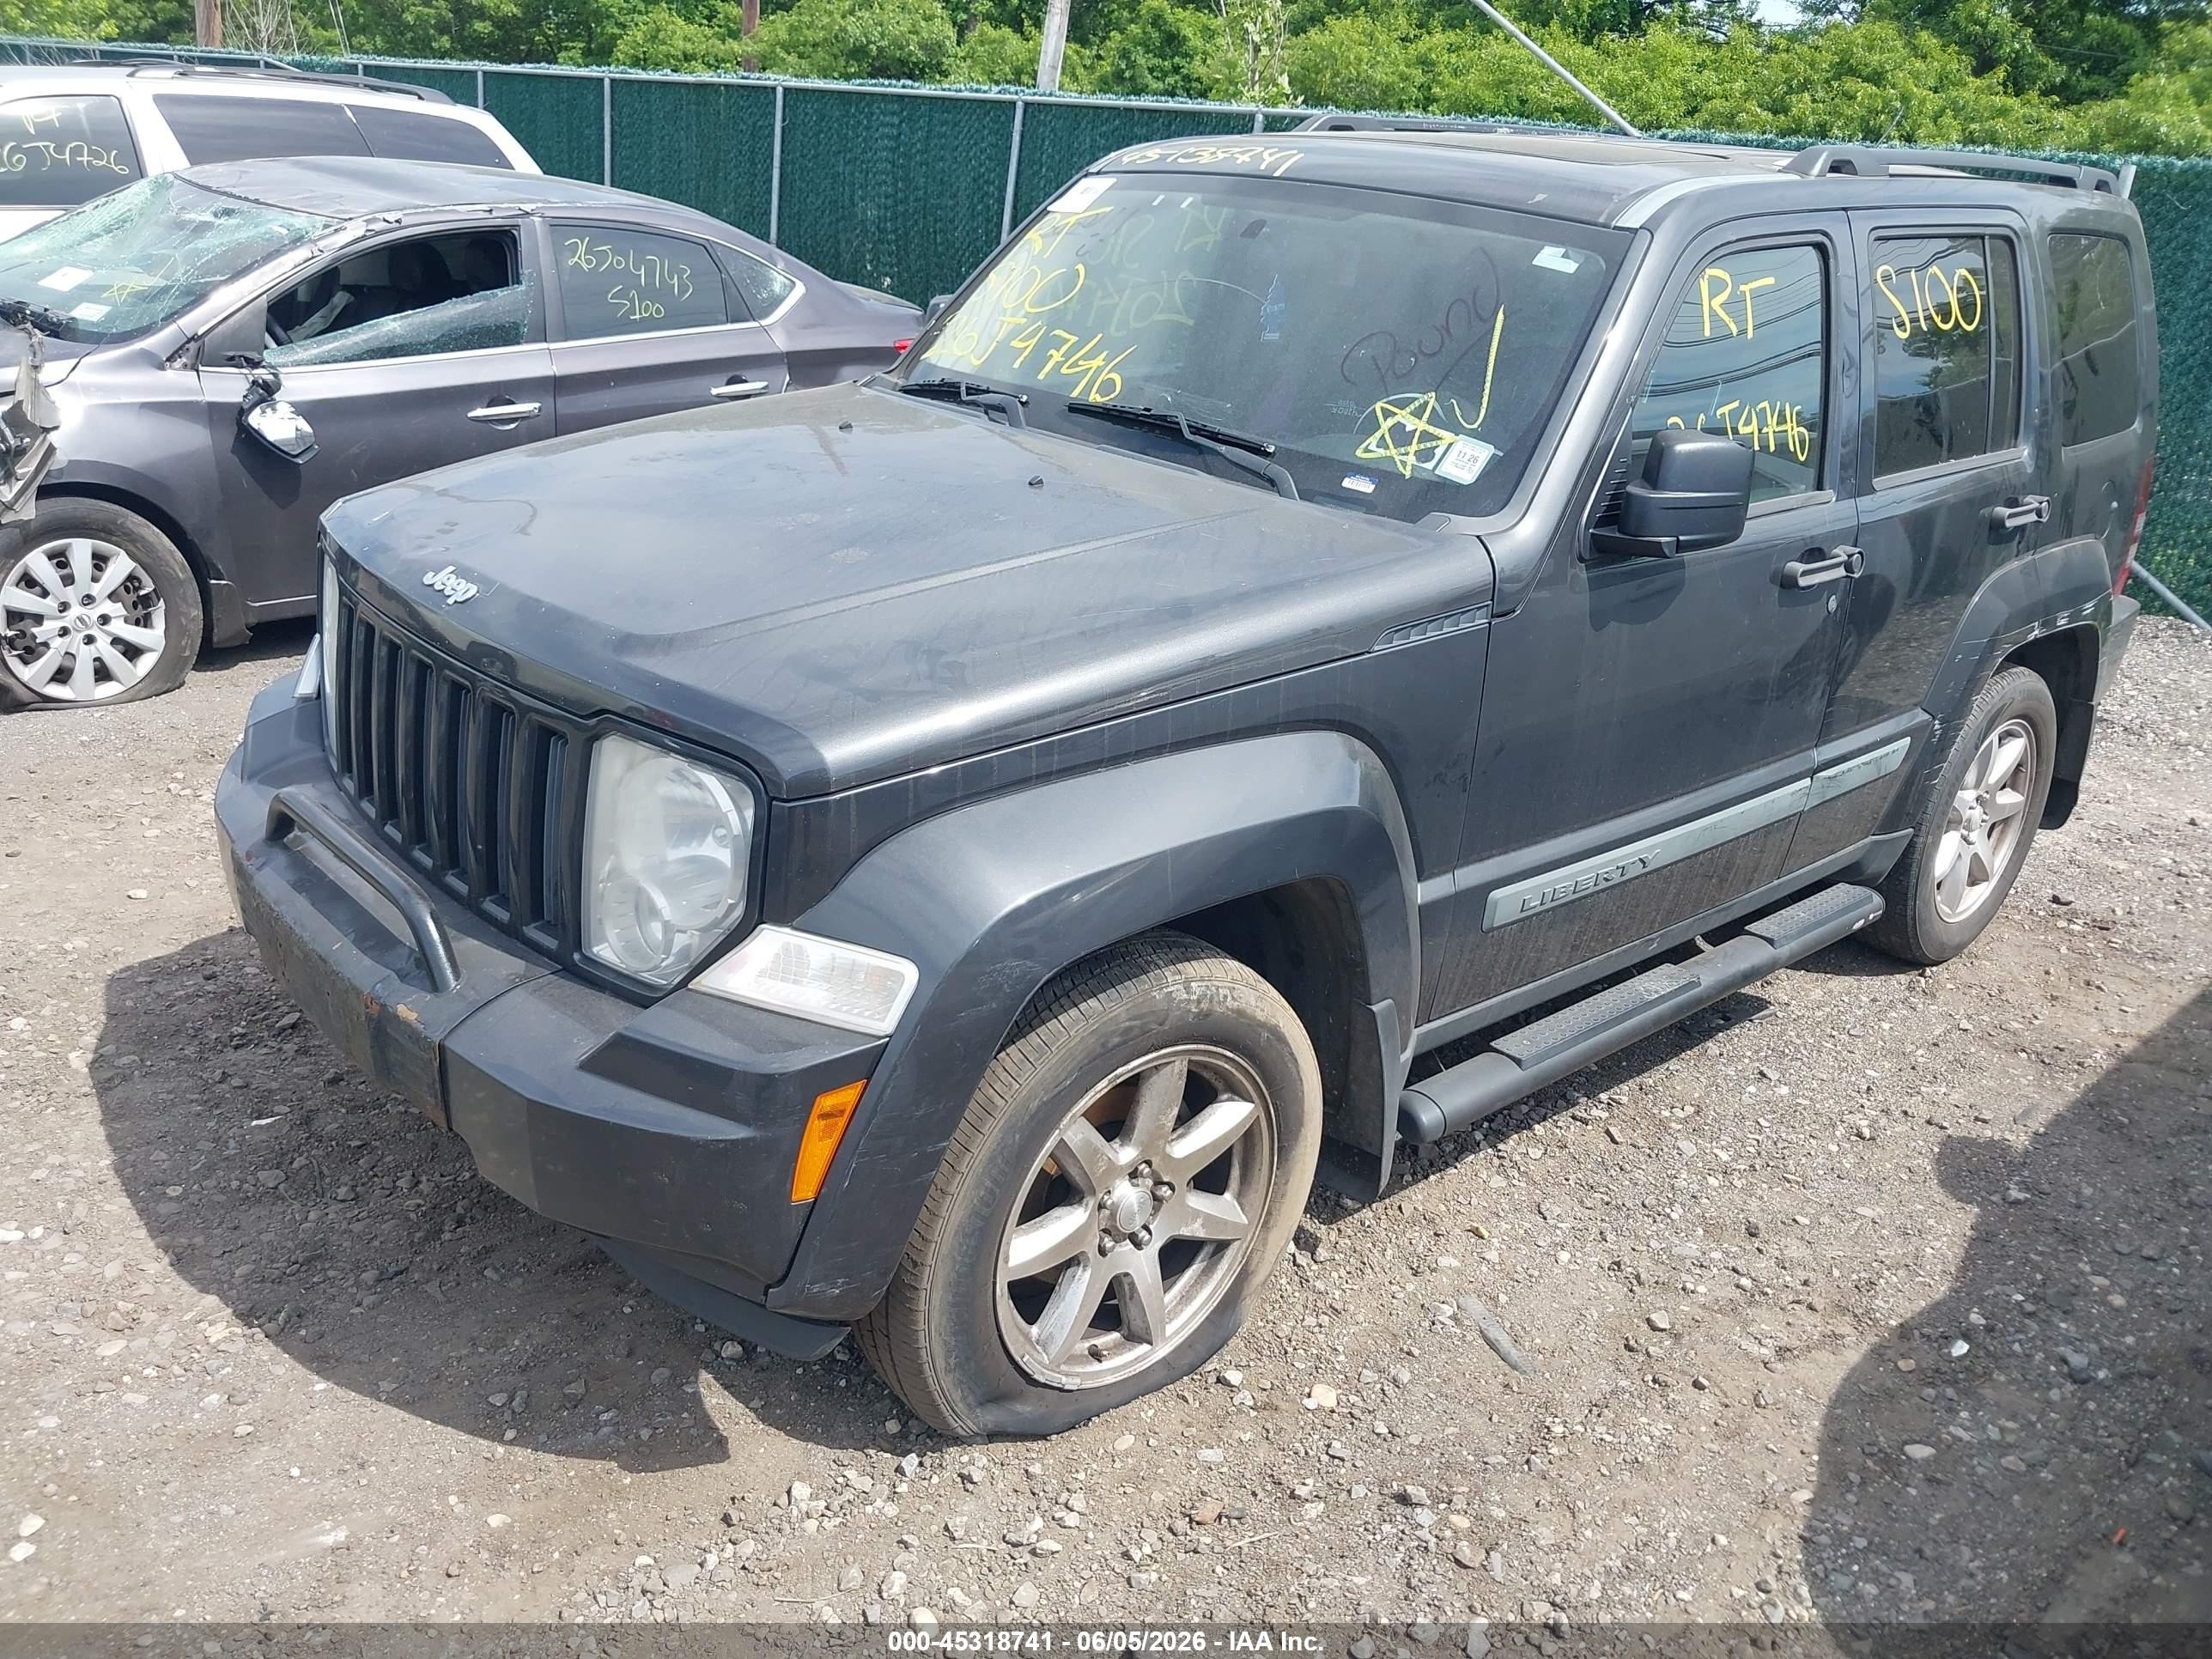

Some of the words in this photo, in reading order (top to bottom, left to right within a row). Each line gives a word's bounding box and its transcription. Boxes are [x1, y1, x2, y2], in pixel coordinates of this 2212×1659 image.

[0, 142, 130, 174] 6J4726
[608, 285, 665, 322] S100
[1698, 268, 1775, 339] RT
[1876, 264, 1981, 339] S100
[1667, 399, 1809, 462] T4746
[422, 565, 478, 605] Jeep
[1519, 848, 1662, 914] LIBERTY
